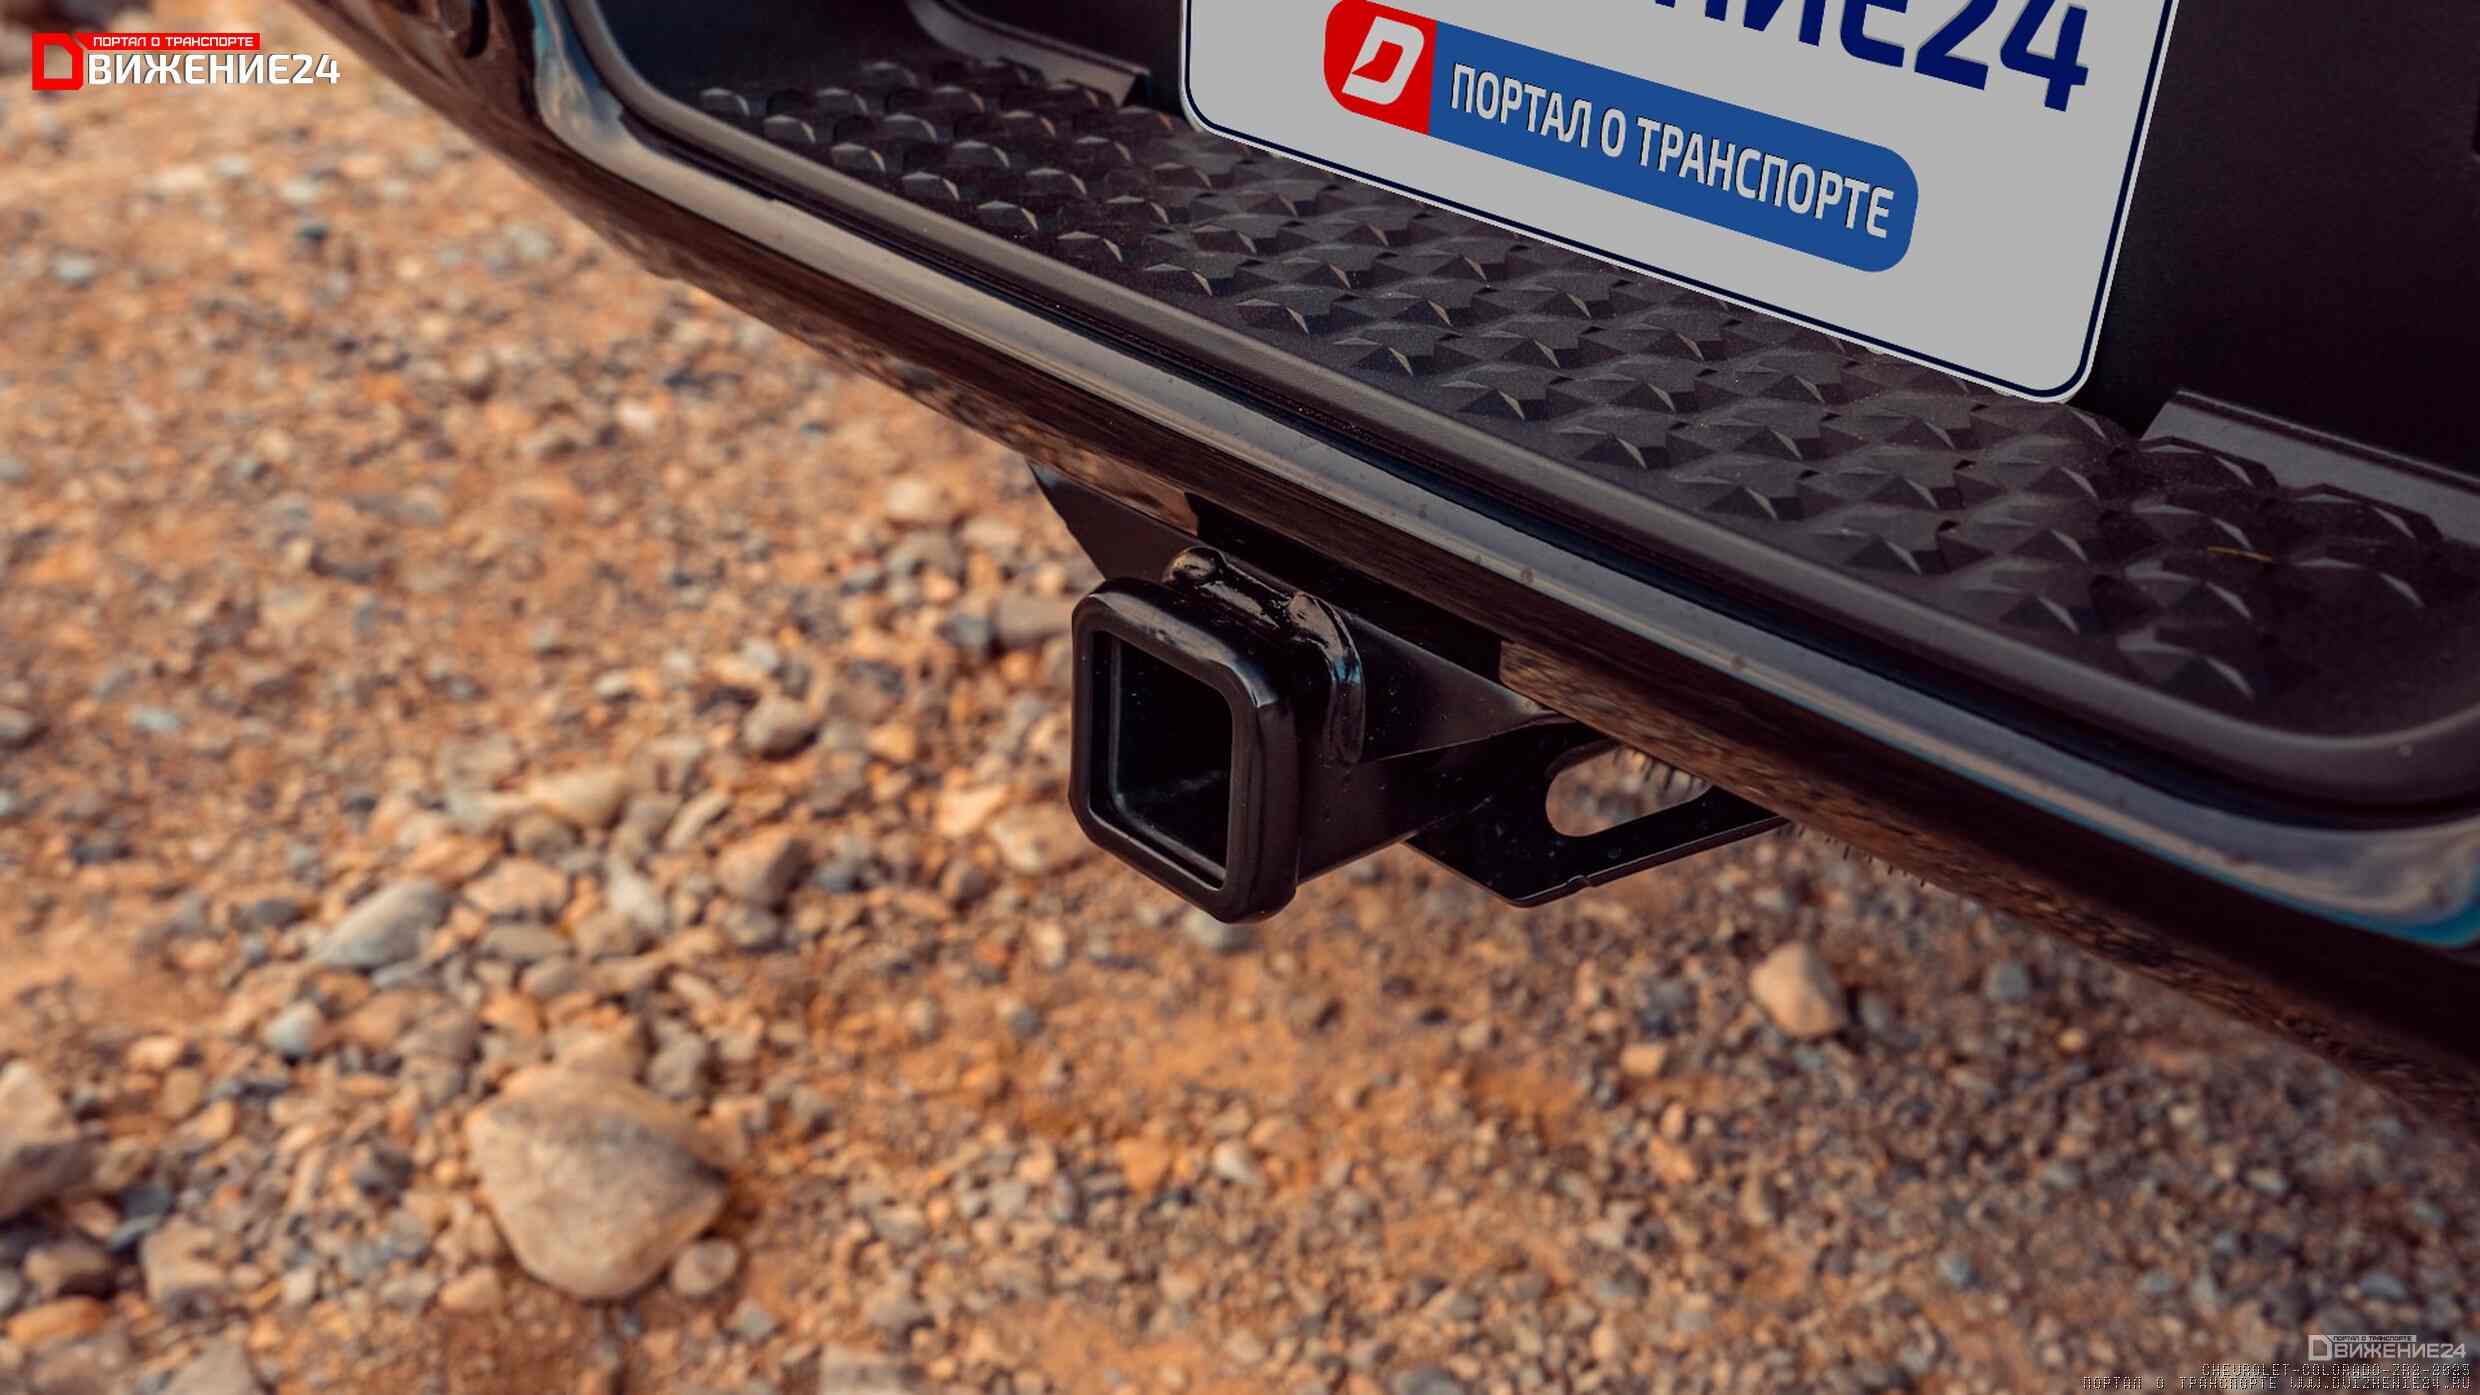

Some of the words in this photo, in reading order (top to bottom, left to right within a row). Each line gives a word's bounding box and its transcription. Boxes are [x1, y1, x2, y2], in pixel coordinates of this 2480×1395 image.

[1451, 62, 1594, 147] ПОРТАЛ
[1601, 106, 1625, 158] О
[1638, 117, 1894, 239] ТРАНСПОРТЕ
